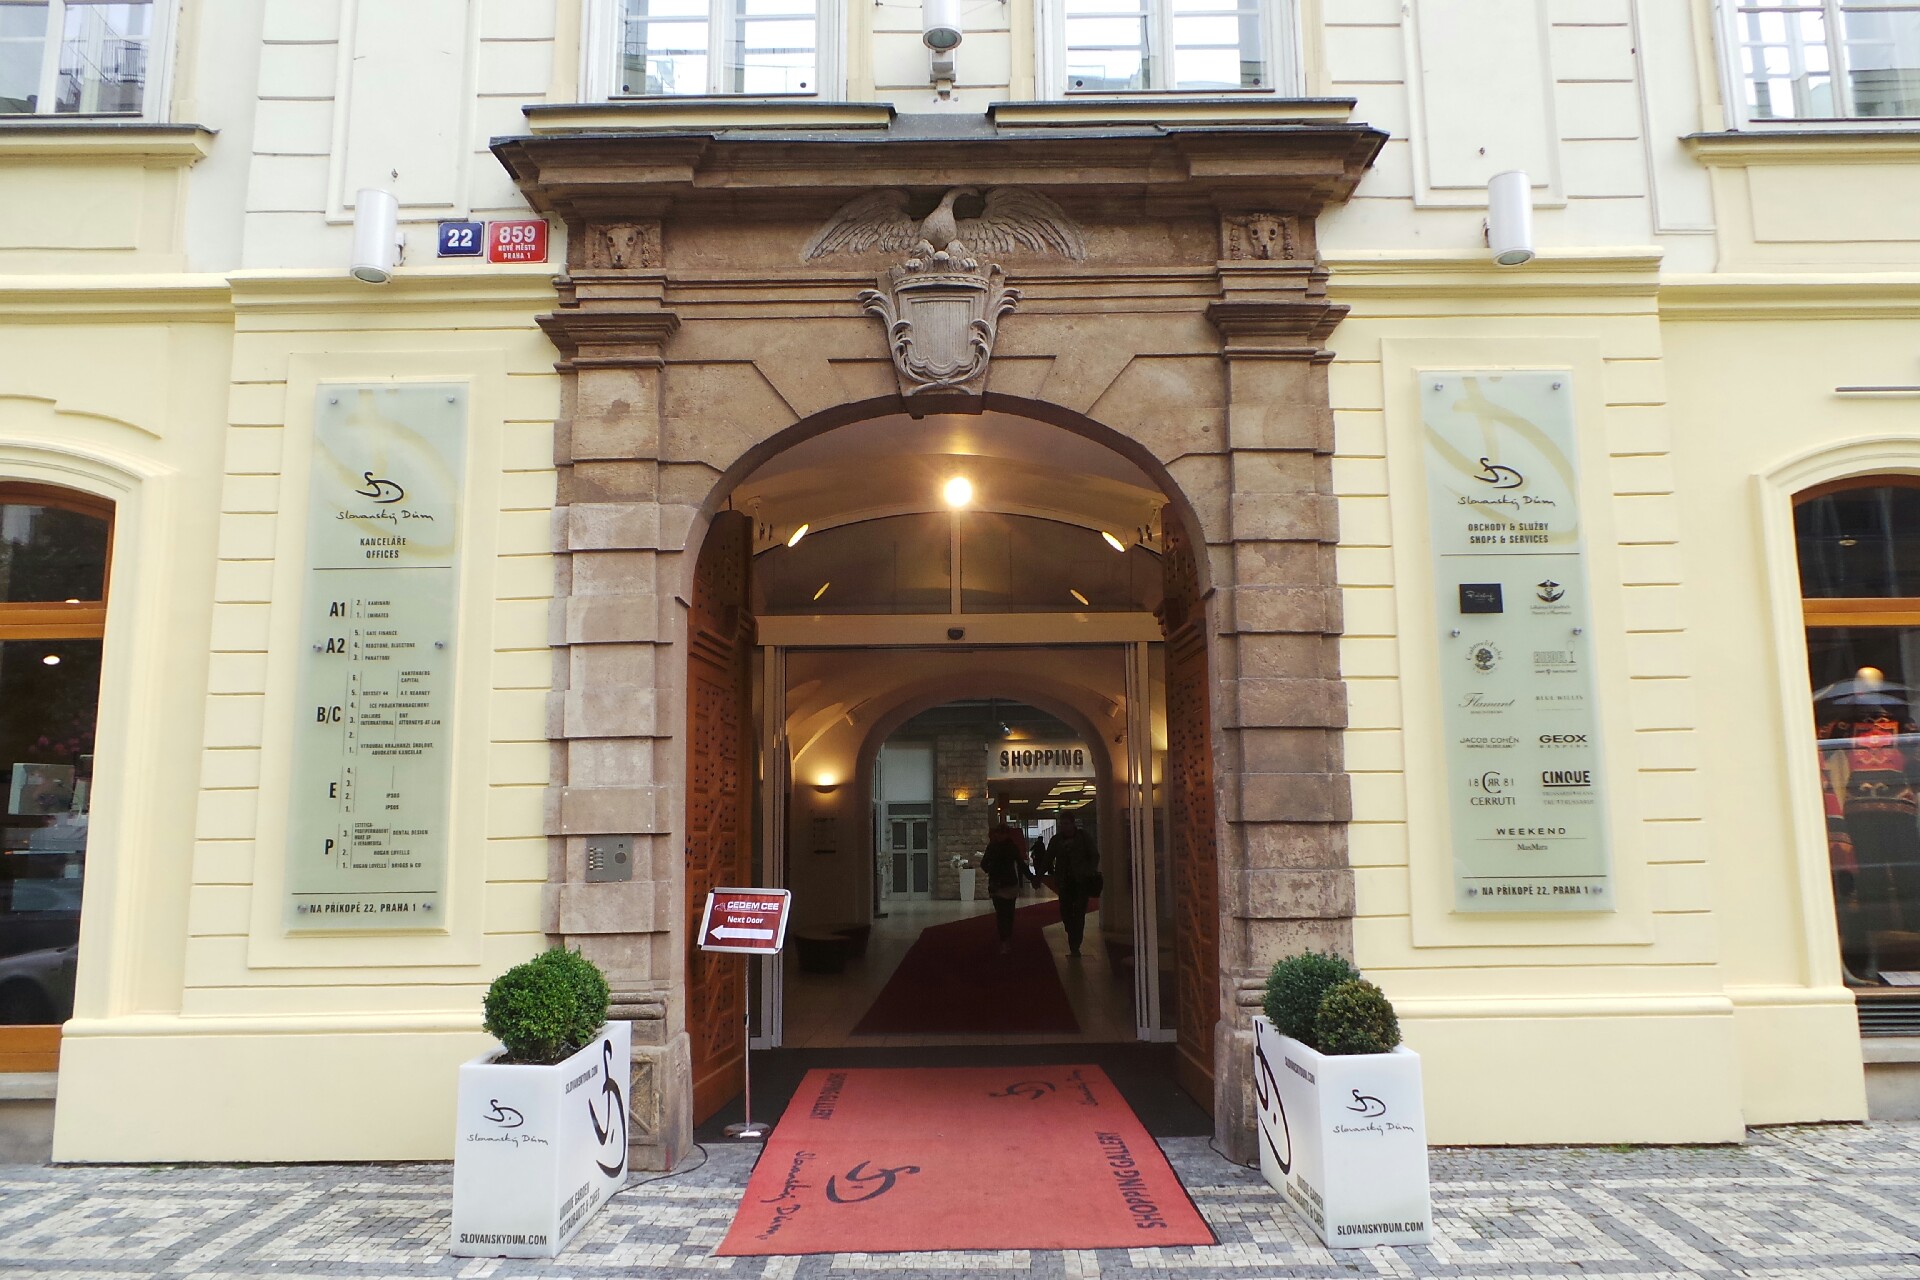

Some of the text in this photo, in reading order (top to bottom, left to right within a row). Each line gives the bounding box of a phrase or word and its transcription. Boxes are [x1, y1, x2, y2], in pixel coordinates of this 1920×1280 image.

[447, 229, 473, 247] 22
[499, 225, 536, 244] 859
[1468, 523, 1506, 531] OBCHODY
[359, 535, 407, 546] KANCELÁŘE
[1470, 535, 1497, 544] SHOPS
[1509, 535, 1549, 543] SERVICES
[366, 550, 399, 559] OFFICES
[329, 601, 345, 617] A1
[325, 637, 345, 654] A2
[316, 706, 341, 724] B/C
[1539, 734, 1587, 744] GEOX
[1000, 749, 1083, 767] SHOPPING
[1542, 770, 1591, 784] CINQUE
[329, 782, 337, 799] E
[1470, 796, 1515, 806] CERRUTI
[1496, 827, 1567, 836] WEEKEND
[324, 838, 334, 855] P
[1482, 886, 1494, 895] NA
[1553, 885, 1581, 895] PRAHA
[1584, 886, 1589, 894] 1
[310, 904, 322, 913] NA
[380, 903, 409, 912] PRAHA
[412, 903, 416, 912] 1
[760, 902, 779, 911] CEE
[727, 915, 745, 924] Next
[1094, 1130, 1168, 1229] SHOPPING GALLERY
[1337, 1221, 1425, 1236] SLOVANSKYDUM.COM
[460, 1233, 547, 1245] SLOVANSKYDUM.COM
